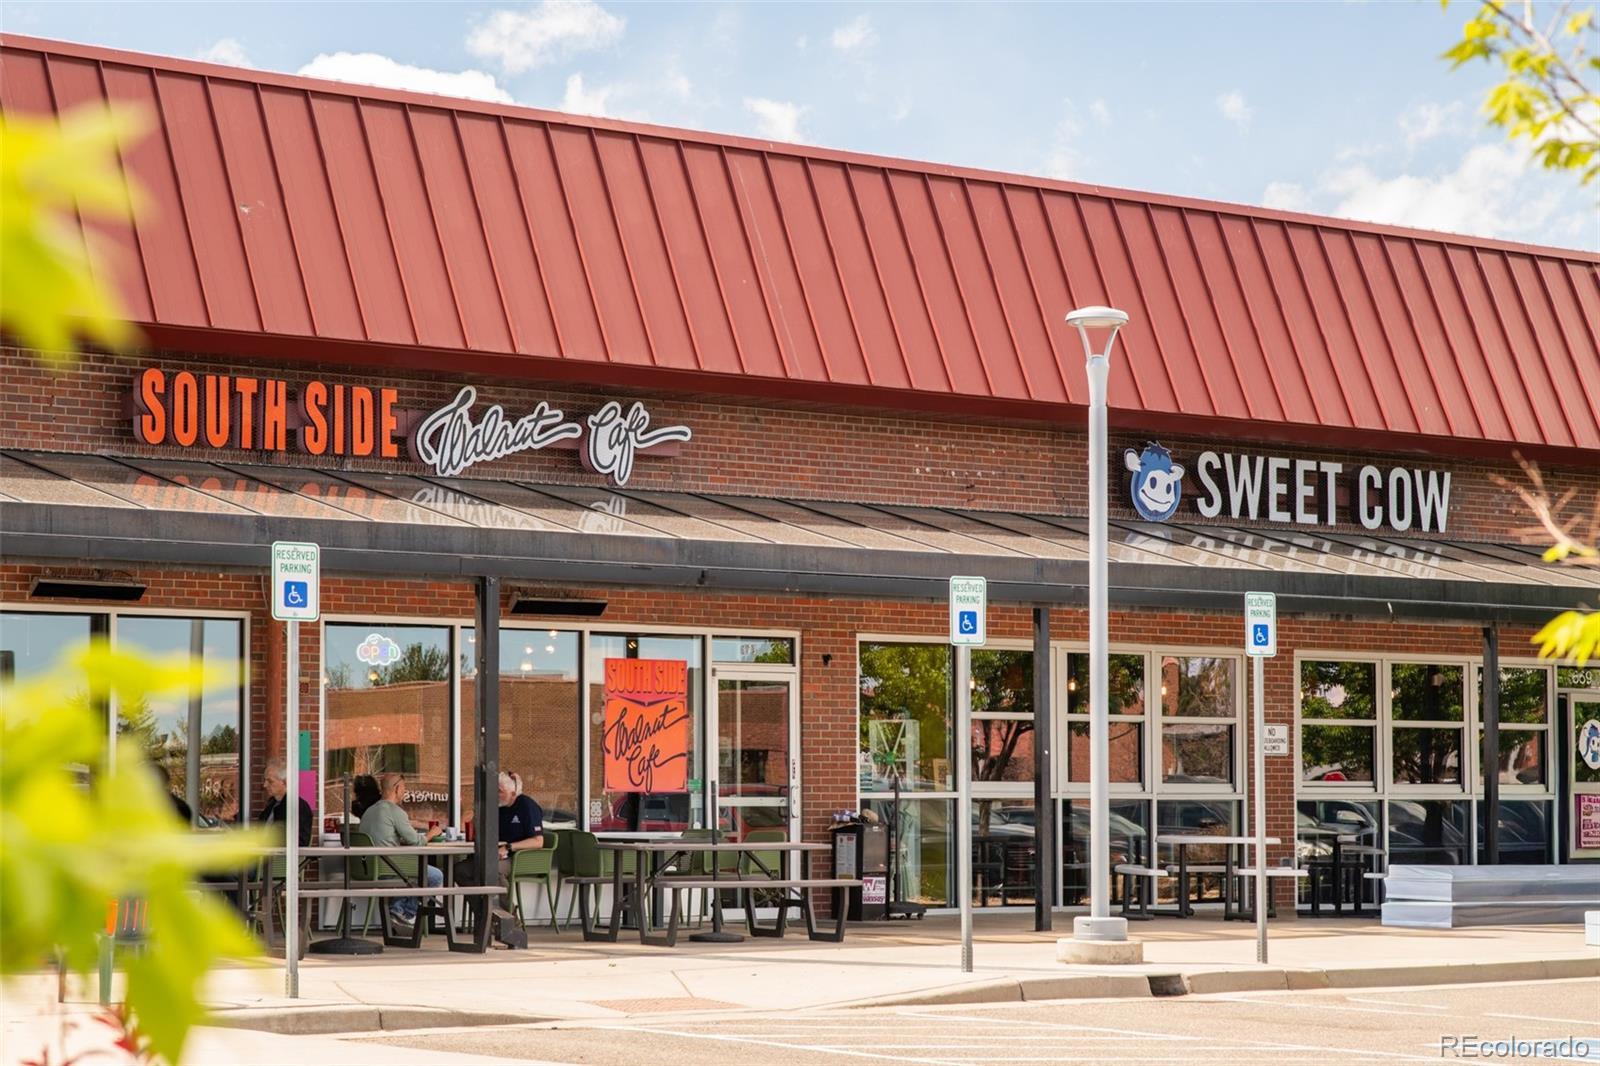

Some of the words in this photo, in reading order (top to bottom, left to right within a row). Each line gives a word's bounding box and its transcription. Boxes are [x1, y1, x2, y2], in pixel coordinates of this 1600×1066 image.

[141, 367, 287, 451] SOUTH
[304, 381, 399, 458] SIDE
[417, 386, 581, 476] Walnut
[588, 401, 691, 485] Cafe
[1197, 451, 1342, 526] SWEET
[1359, 465, 1451, 534] COW
[276, 549, 316, 561] RESERVED
[280, 562, 312, 575] PARKING
[952, 583, 983, 593] RESERVED
[956, 595, 980, 604] PARKING
[1248, 598, 1273, 607] RESERVED
[1250, 609, 1271, 618] PARKING
[606, 662, 653, 694] SOUTH
[655, 664, 685, 695] SIDE
[602, 706, 689, 761] Walnut
[1267, 728, 1276, 736] NO
[626, 744, 687, 793] Cafe
